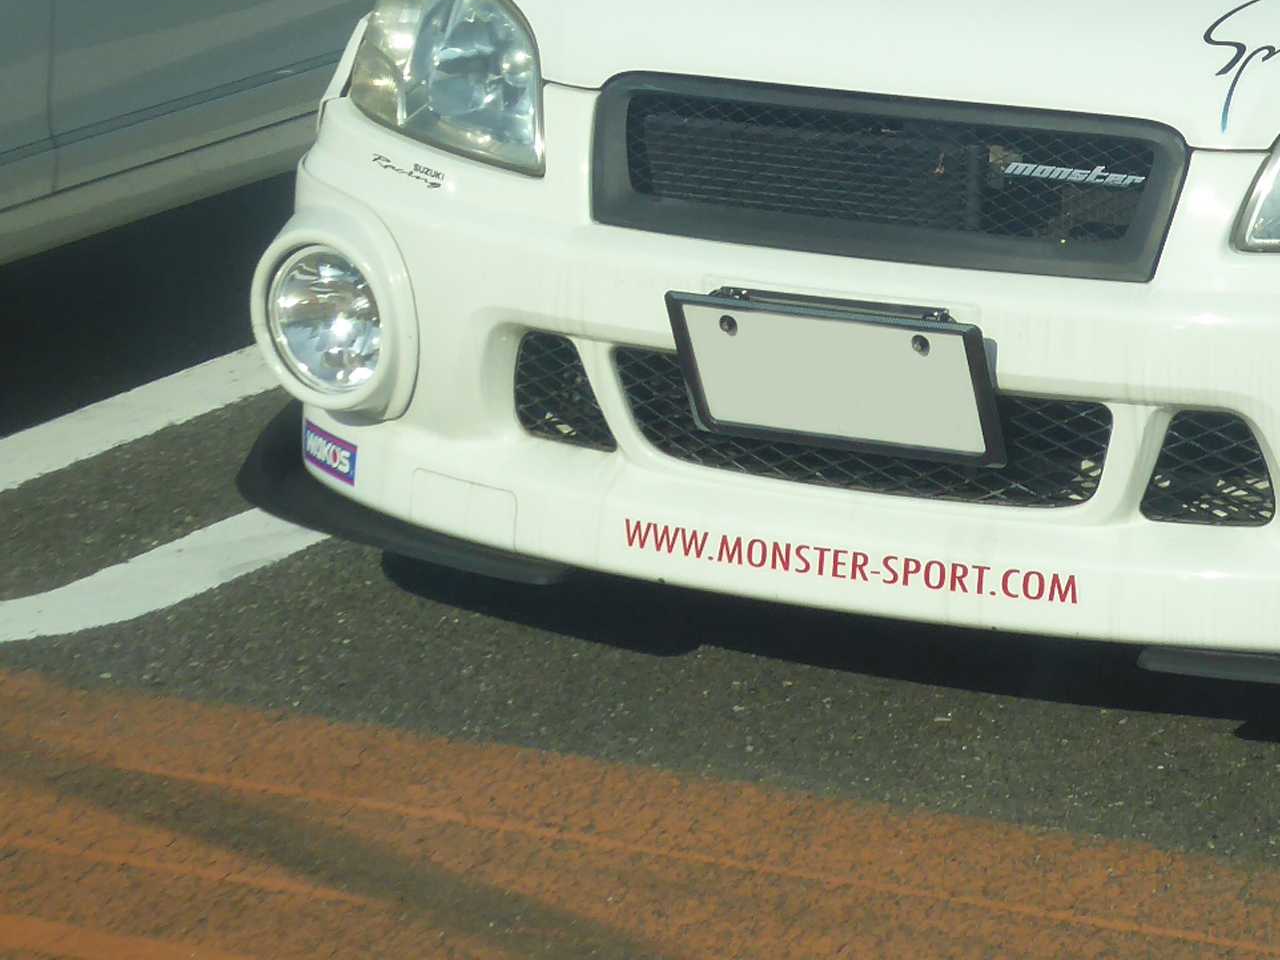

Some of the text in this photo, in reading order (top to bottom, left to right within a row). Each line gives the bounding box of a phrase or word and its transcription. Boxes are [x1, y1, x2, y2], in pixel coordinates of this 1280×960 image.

[413, 163, 446, 181] SUZUKI
[1003, 161, 1146, 189] monster
[624, 517, 1079, 604] WWW.MONSTER-SPORT.COM
